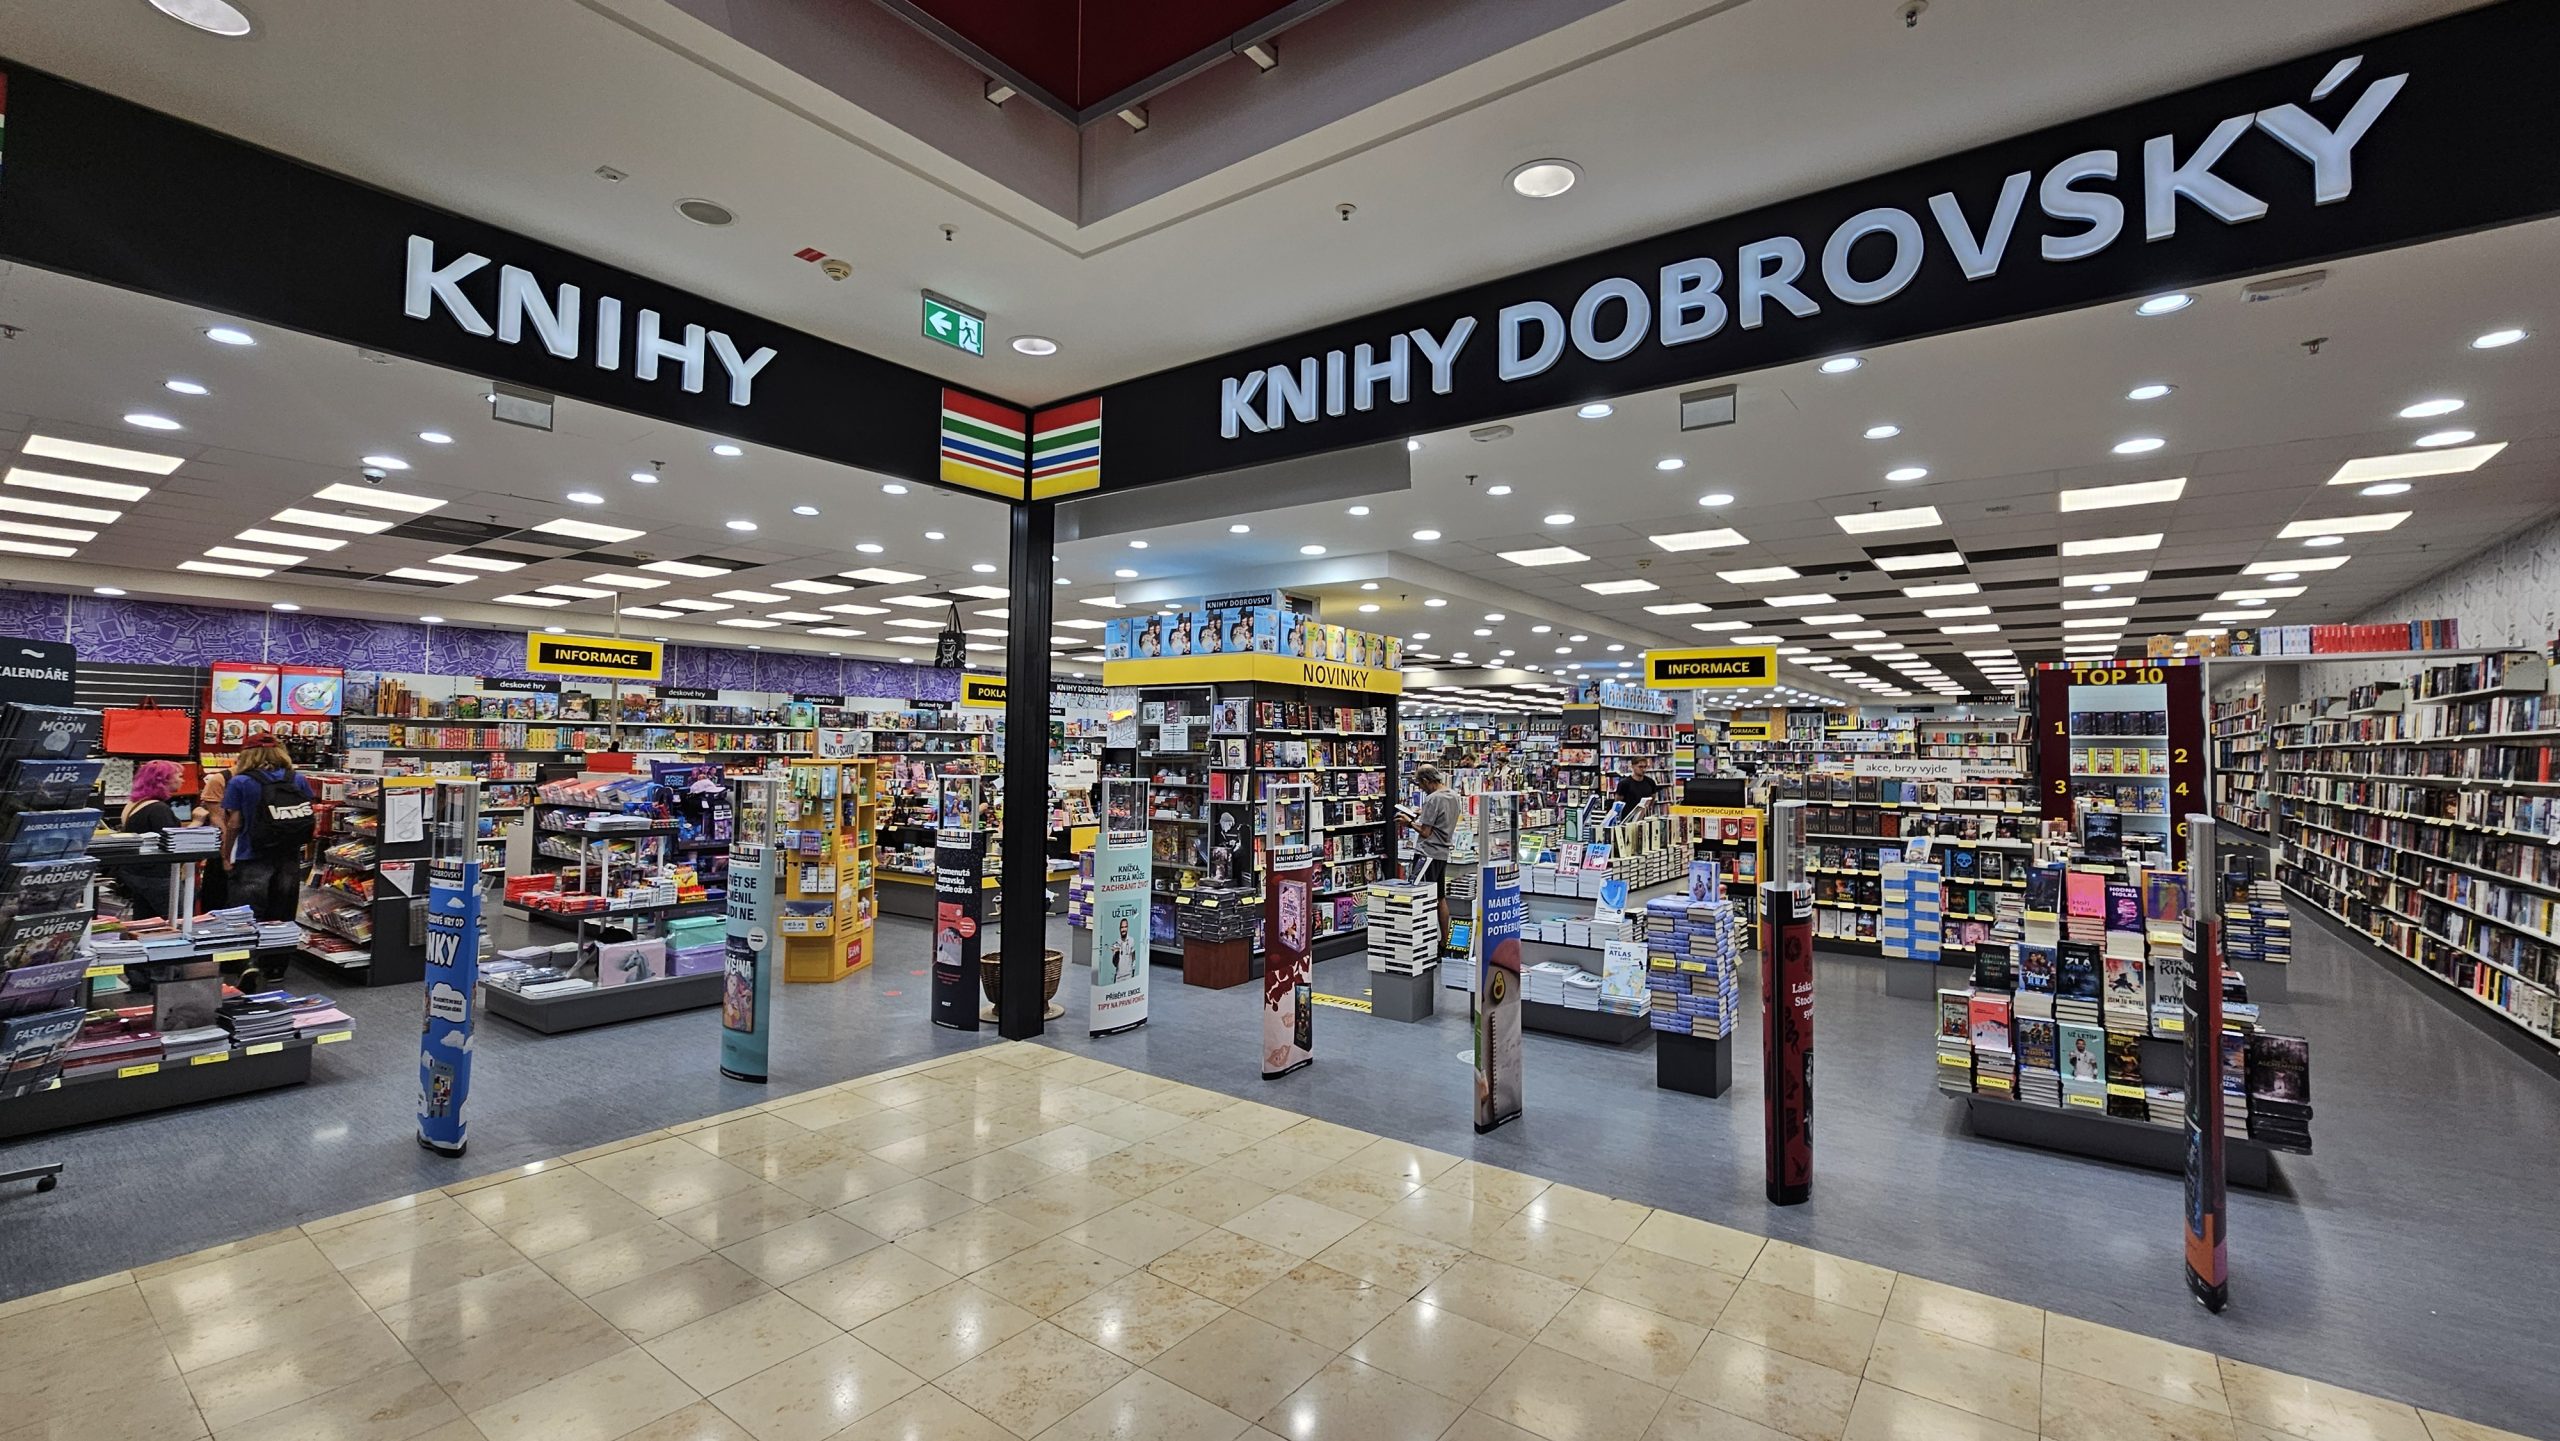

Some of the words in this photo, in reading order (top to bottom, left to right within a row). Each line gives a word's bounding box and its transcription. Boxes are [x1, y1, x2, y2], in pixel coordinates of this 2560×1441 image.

[1220, 316, 1477, 440] KNIHY
[1499, 55, 2409, 383] DOBROVSKÝ
[404, 234, 778, 406] KNIHY
[1207, 600, 1228, 609] KNIHY
[555, 648, 639, 665] INFORMACE
[1668, 661, 1750, 675] INFORMACE
[1303, 663, 1369, 688] NOVINKY
[2072, 669, 2127, 686] TOP
[2136, 668, 2164, 684] 10
[500, 680, 532, 690] deskové
[532, 682, 546, 692] hry
[1057, 683, 1078, 692] KNIHY
[668, 688, 693, 697] deskové
[693, 689, 706, 699] hry
[39, 721, 86, 734] MOON
[2054, 721, 2066, 735] 1
[2174, 748, 2188, 763] 2
[1866, 763, 1892, 773] akce,
[1894, 763, 1917, 775] brzy
[1919, 764, 1948, 775] vyjde
[43, 771, 81, 783] ALPS
[2055, 780, 2067, 794] 3
[2175, 782, 2189, 796] 4
[268, 802, 314, 820] VANS
[24, 822, 59, 832] AURORA
[2176, 822, 2187, 837] 6
[1276, 854, 1294, 862] KNIHY
[20, 869, 90, 886] GARDENS
[744, 877, 757, 889] SE
[1488, 894, 1512, 909] MÁME
[740, 908, 757, 921] NE.
[1112, 908, 1121, 919] UŽ
[1488, 911, 1500, 923] CO
[1501, 909, 1513, 921] DO
[14, 920, 84, 940] FLOWERS
[14, 969, 81, 989] PROVENCE
[14, 1026, 44, 1041] FAST
[45, 1020, 75, 1034] CARS
